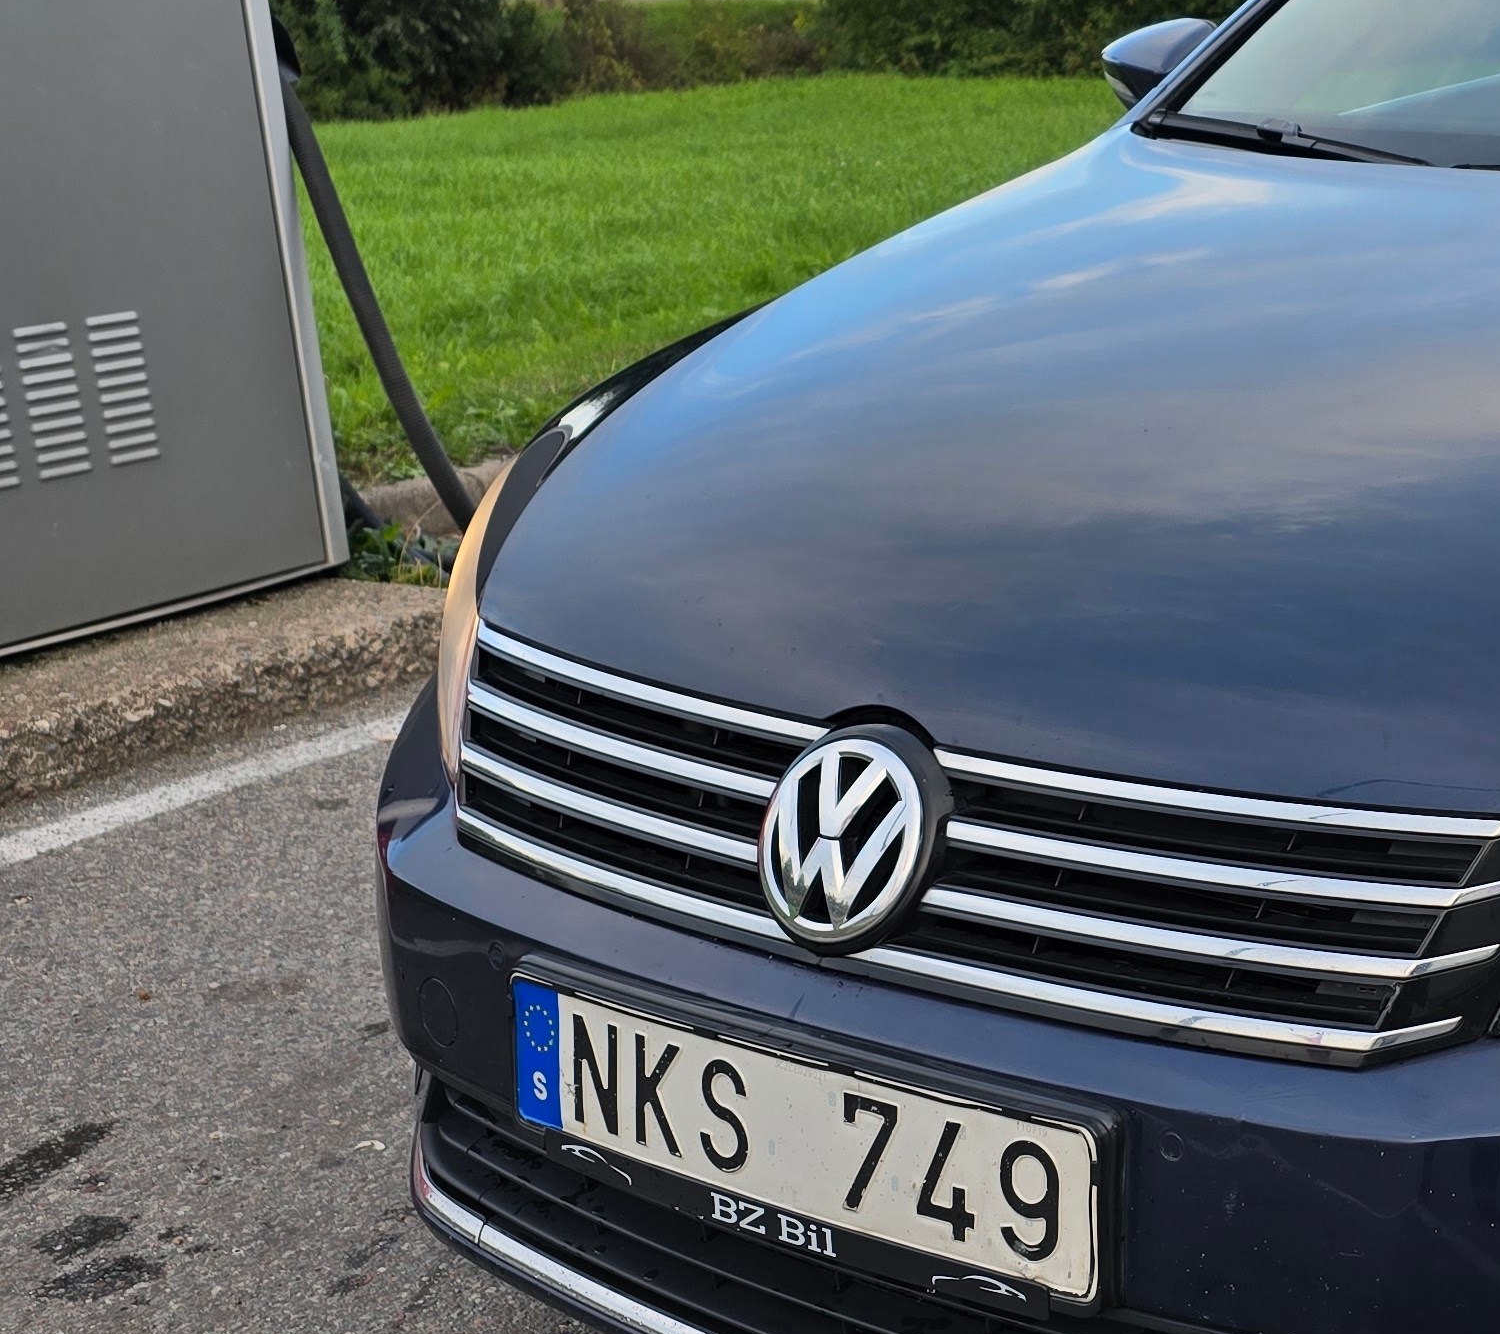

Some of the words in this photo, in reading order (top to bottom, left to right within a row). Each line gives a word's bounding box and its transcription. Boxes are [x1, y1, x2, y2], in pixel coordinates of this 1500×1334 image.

[532, 1070, 548, 1101] S
[572, 1012, 749, 1174] NKS
[842, 1091, 1060, 1262] 749
[710, 1191, 766, 1235] BZ
[777, 1213, 837, 1258] Bil
